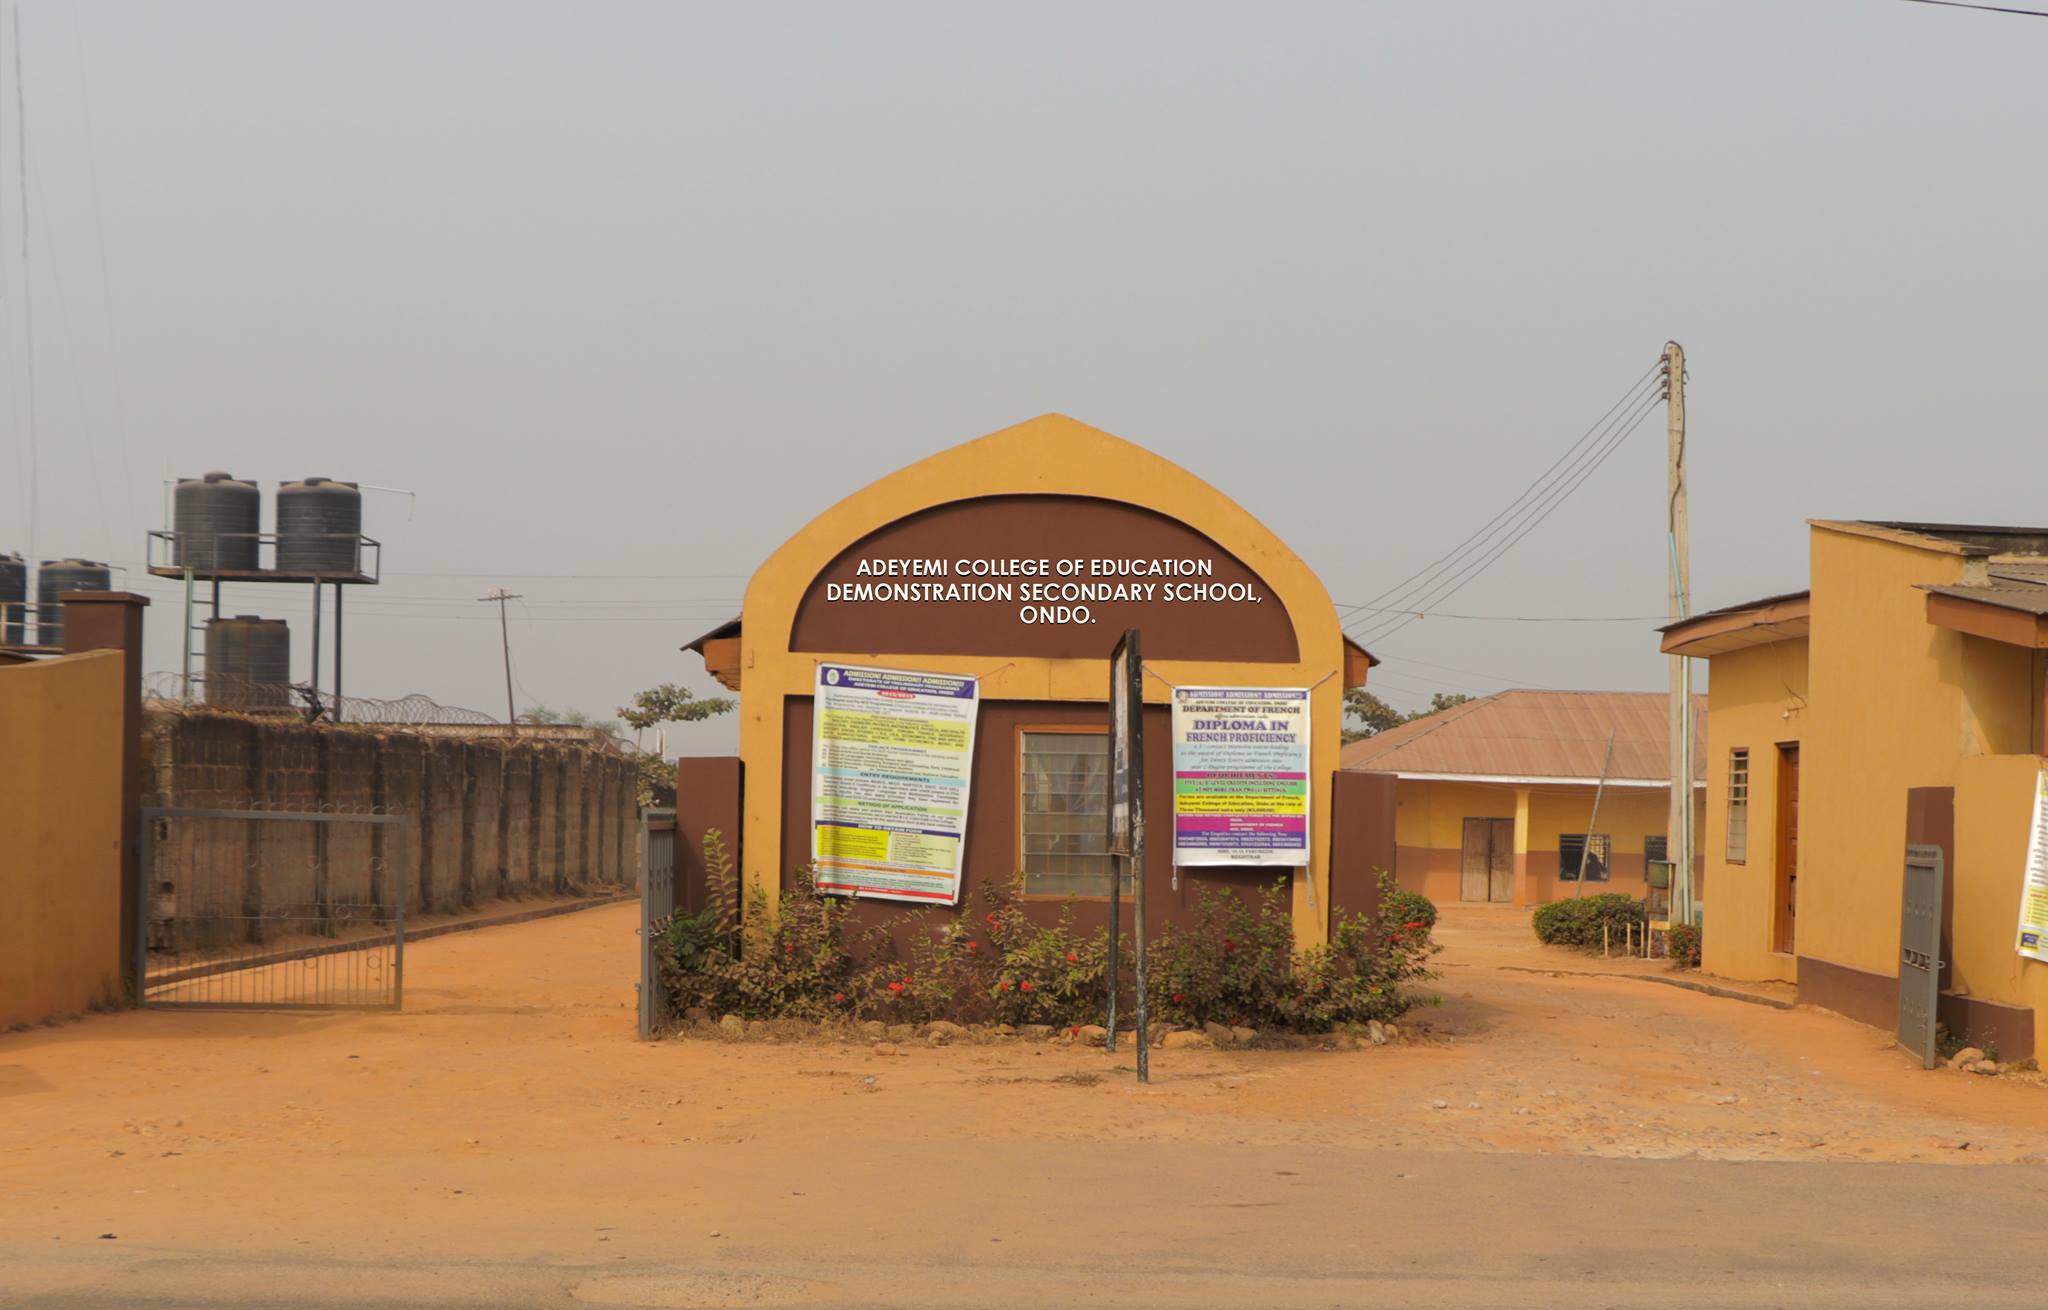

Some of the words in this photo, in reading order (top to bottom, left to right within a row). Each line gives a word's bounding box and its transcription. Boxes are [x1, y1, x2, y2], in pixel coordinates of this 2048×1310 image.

[856, 559, 948, 576] ADEYEMI
[954, 559, 1050, 576] COLLEGE
[1056, 559, 1085, 576] OF
[1090, 559, 1212, 576] EDUCATION
[826, 582, 1012, 602] DEMONSTRATION
[1019, 582, 1157, 602] SECONDARY
[1163, 582, 1263, 604] SCHOOL,
[1019, 605, 1096, 624] ONDO.
[1182, 705, 1246, 713] DEPARTMENT
[1262, 706, 1301, 714] FRENCH
[1192, 720, 1267, 731] DIPLOMA
[1270, 720, 1289, 731] IN
[1185, 732, 1228, 742] FRENCH
[1229, 733, 1297, 743] PROFICIENCY
